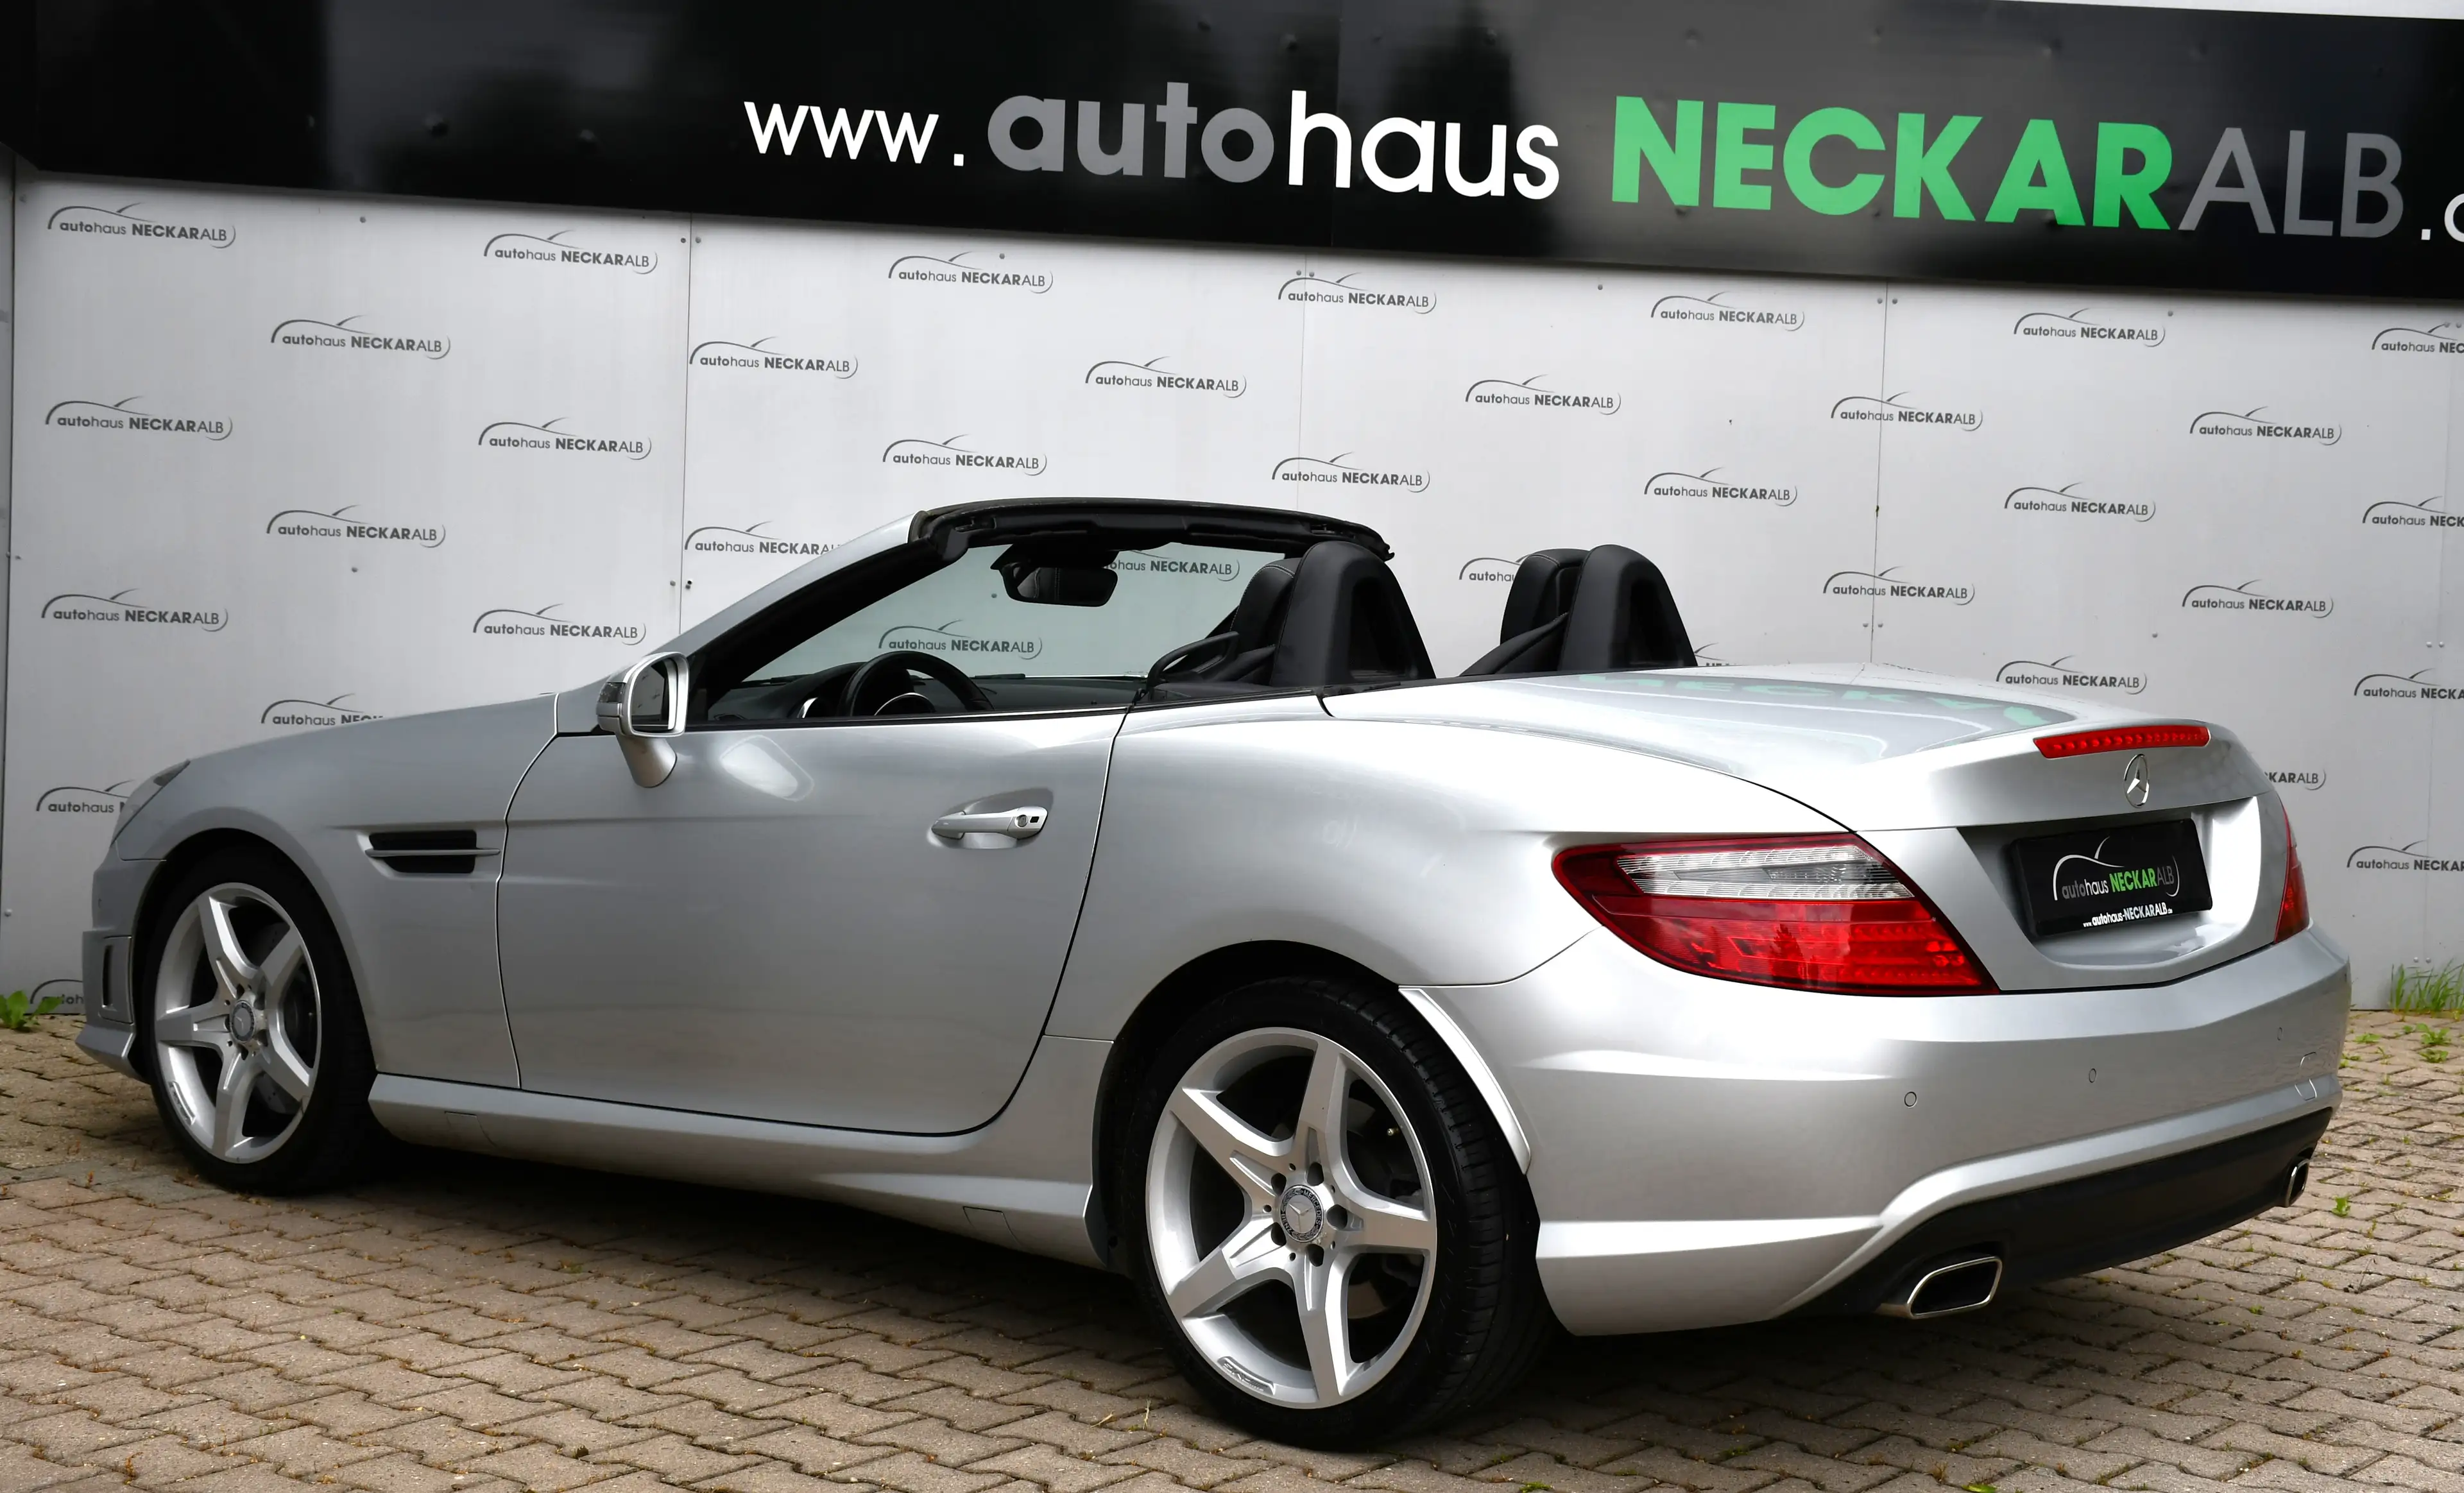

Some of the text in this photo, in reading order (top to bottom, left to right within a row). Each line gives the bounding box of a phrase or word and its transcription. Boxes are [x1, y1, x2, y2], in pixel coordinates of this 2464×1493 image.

[60, 221, 227, 241] autohaus NECKARALB
[495, 248, 649, 267] autohaus NECKARALB
[899, 270, 1045, 286] autohaus NECKARALB
[1288, 292, 1428, 307] autohaus NECKARALB
[1661, 310, 1797, 324] autohaus NECKARALB
[2023, 327, 2157, 340] autohaus NECKARALB
[282, 334, 441, 352] autohaus NECKARALB
[2381, 342, 2434, 352] autohaus
[700, 356, 850, 371] autohaus NECKARALB
[1096, 375, 1238, 391] autohaus NECKARALB
[1475, 394, 1613, 408] autohaus NECKARALB
[57, 416, 223, 433] autohaus NECKARALB
[1840, 411, 1975, 425] autohaus NECKARALB
[2200, 425, 2334, 439] autohaus NECKARALB
[490, 437, 643, 453] autohaus NECKARALB
[893, 454, 1038, 468] autohaus NECKARALB
[1282, 472, 1422, 486] autohaus NECKARALB
[1654, 486, 1790, 500] autohaus NECKARALB
[2014, 501, 2148, 515] autohaus NECKARALB
[2372, 515, 2425, 525] autohaus
[278, 525, 436, 540] autohaus NECKARALB
[695, 542, 754, 552] autohaus
[1151, 561, 1231, 574] NECKARALB
[1833, 585, 1967, 599] autohaus NECKARALB
[2192, 599, 2325, 611] autohaus NECKARALB
[53, 610, 219, 624] autohaus NECKARALB
[484, 624, 637, 638] autohaus NECKARALB
[889, 640, 1034, 653] autohaus NECKARALB
[2006, 675, 2139, 688] autohaus NECKARALB
[2363, 688, 2416, 697] autohaus
[273, 715, 335, 725] autohaus
[48, 802, 114, 813] autohaus
[2356, 860, 2409, 869] autohaus
[2062, 866, 2175, 899] autohaus NECKARALB
[1303, 1190, 1322, 1225] MERCEDES
